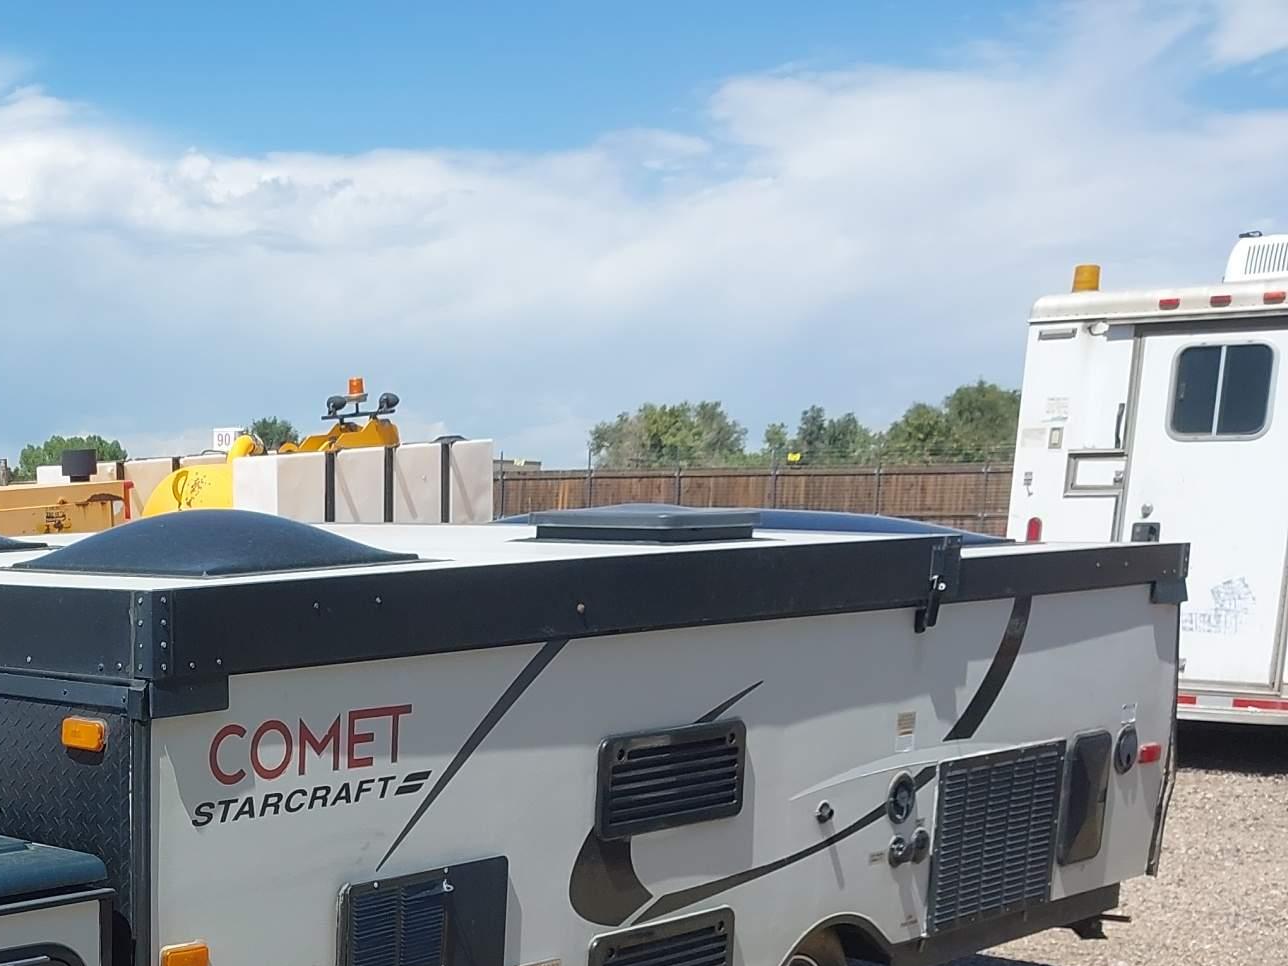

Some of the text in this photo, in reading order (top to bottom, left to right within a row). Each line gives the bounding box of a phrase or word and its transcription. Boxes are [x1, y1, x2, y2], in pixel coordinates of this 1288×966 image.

[217, 433, 231, 447] 90
[209, 703, 413, 786] COMET
[191, 775, 397, 828] STARCRAFT
